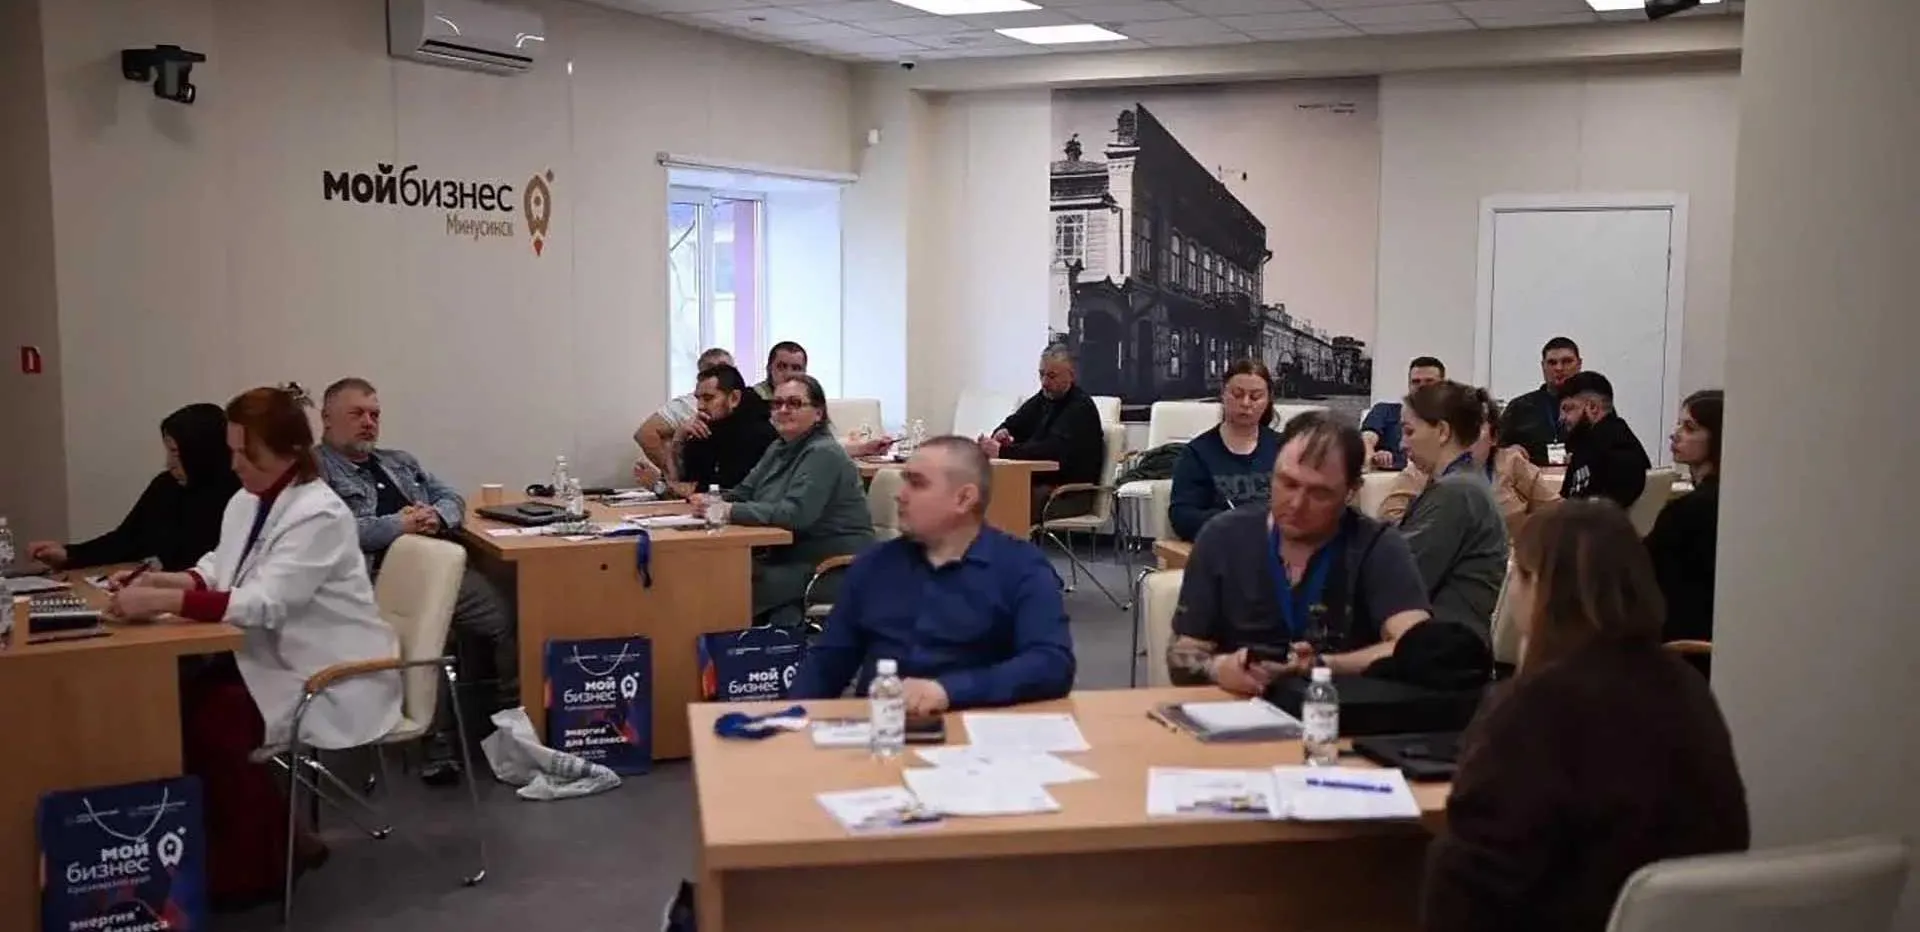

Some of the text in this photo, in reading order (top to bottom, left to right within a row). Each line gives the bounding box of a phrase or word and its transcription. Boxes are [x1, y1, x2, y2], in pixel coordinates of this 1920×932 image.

[446, 214, 514, 241] Минусинск
[749, 667, 779, 682] мой
[585, 676, 617, 691] мой
[728, 680, 780, 694] бизнес
[563, 689, 617, 703] бизнес
[101, 838, 150, 861] мой
[66, 858, 151, 883] бизнес
